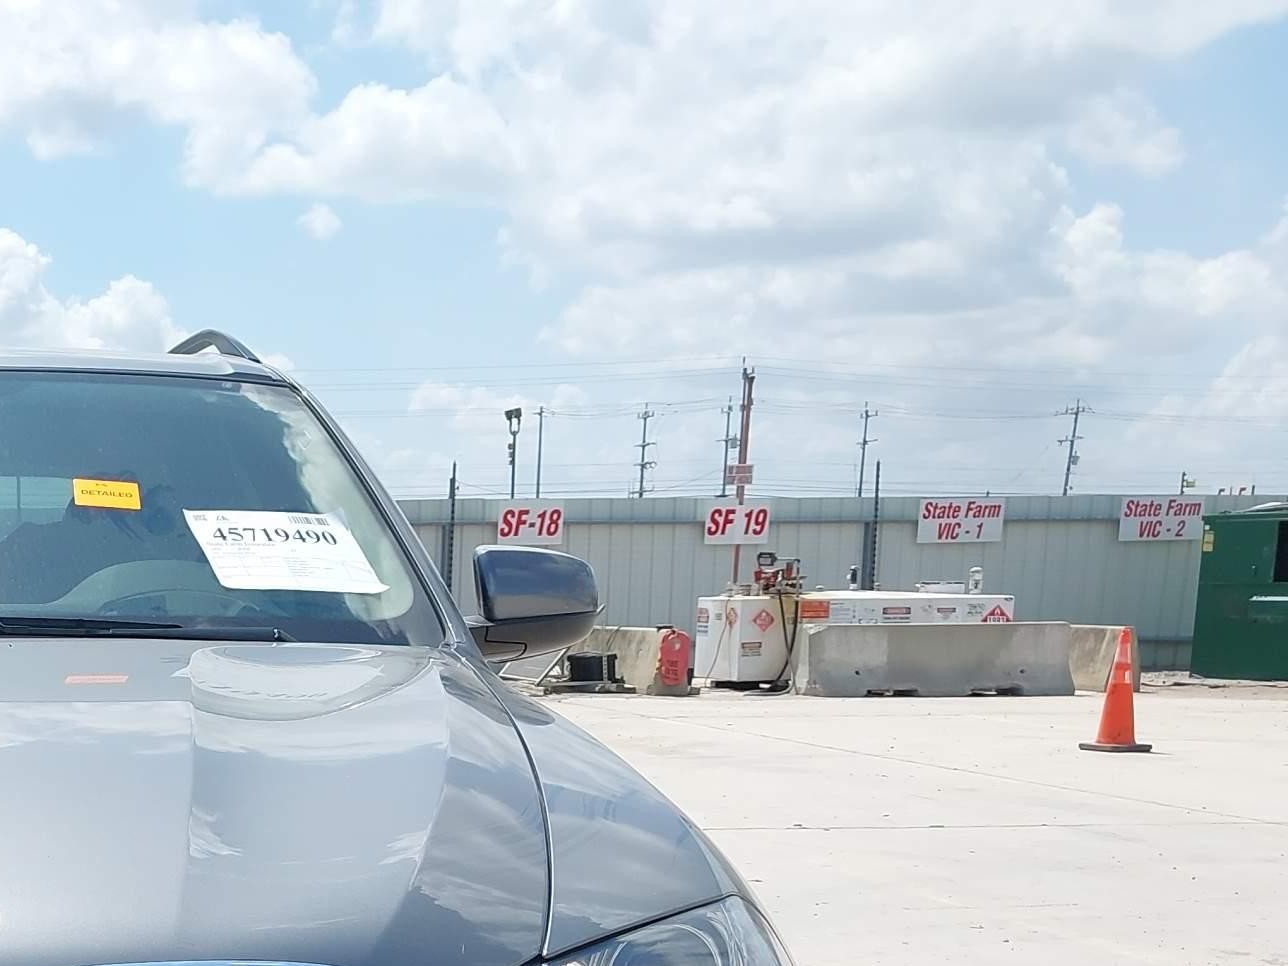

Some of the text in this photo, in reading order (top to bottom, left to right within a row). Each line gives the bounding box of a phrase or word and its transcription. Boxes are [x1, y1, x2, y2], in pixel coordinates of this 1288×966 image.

[922, 501, 1002, 519] State Farm
[1124, 499, 1202, 518] State Farm
[499, 508, 562, 537] SF-18
[707, 508, 768, 536] SF 19
[937, 522, 962, 540] VIC
[976, 522, 984, 539] 1
[1139, 521, 1162, 538] VIC
[1175, 520, 1186, 537] 2
[212, 527, 338, 546] 45719490
